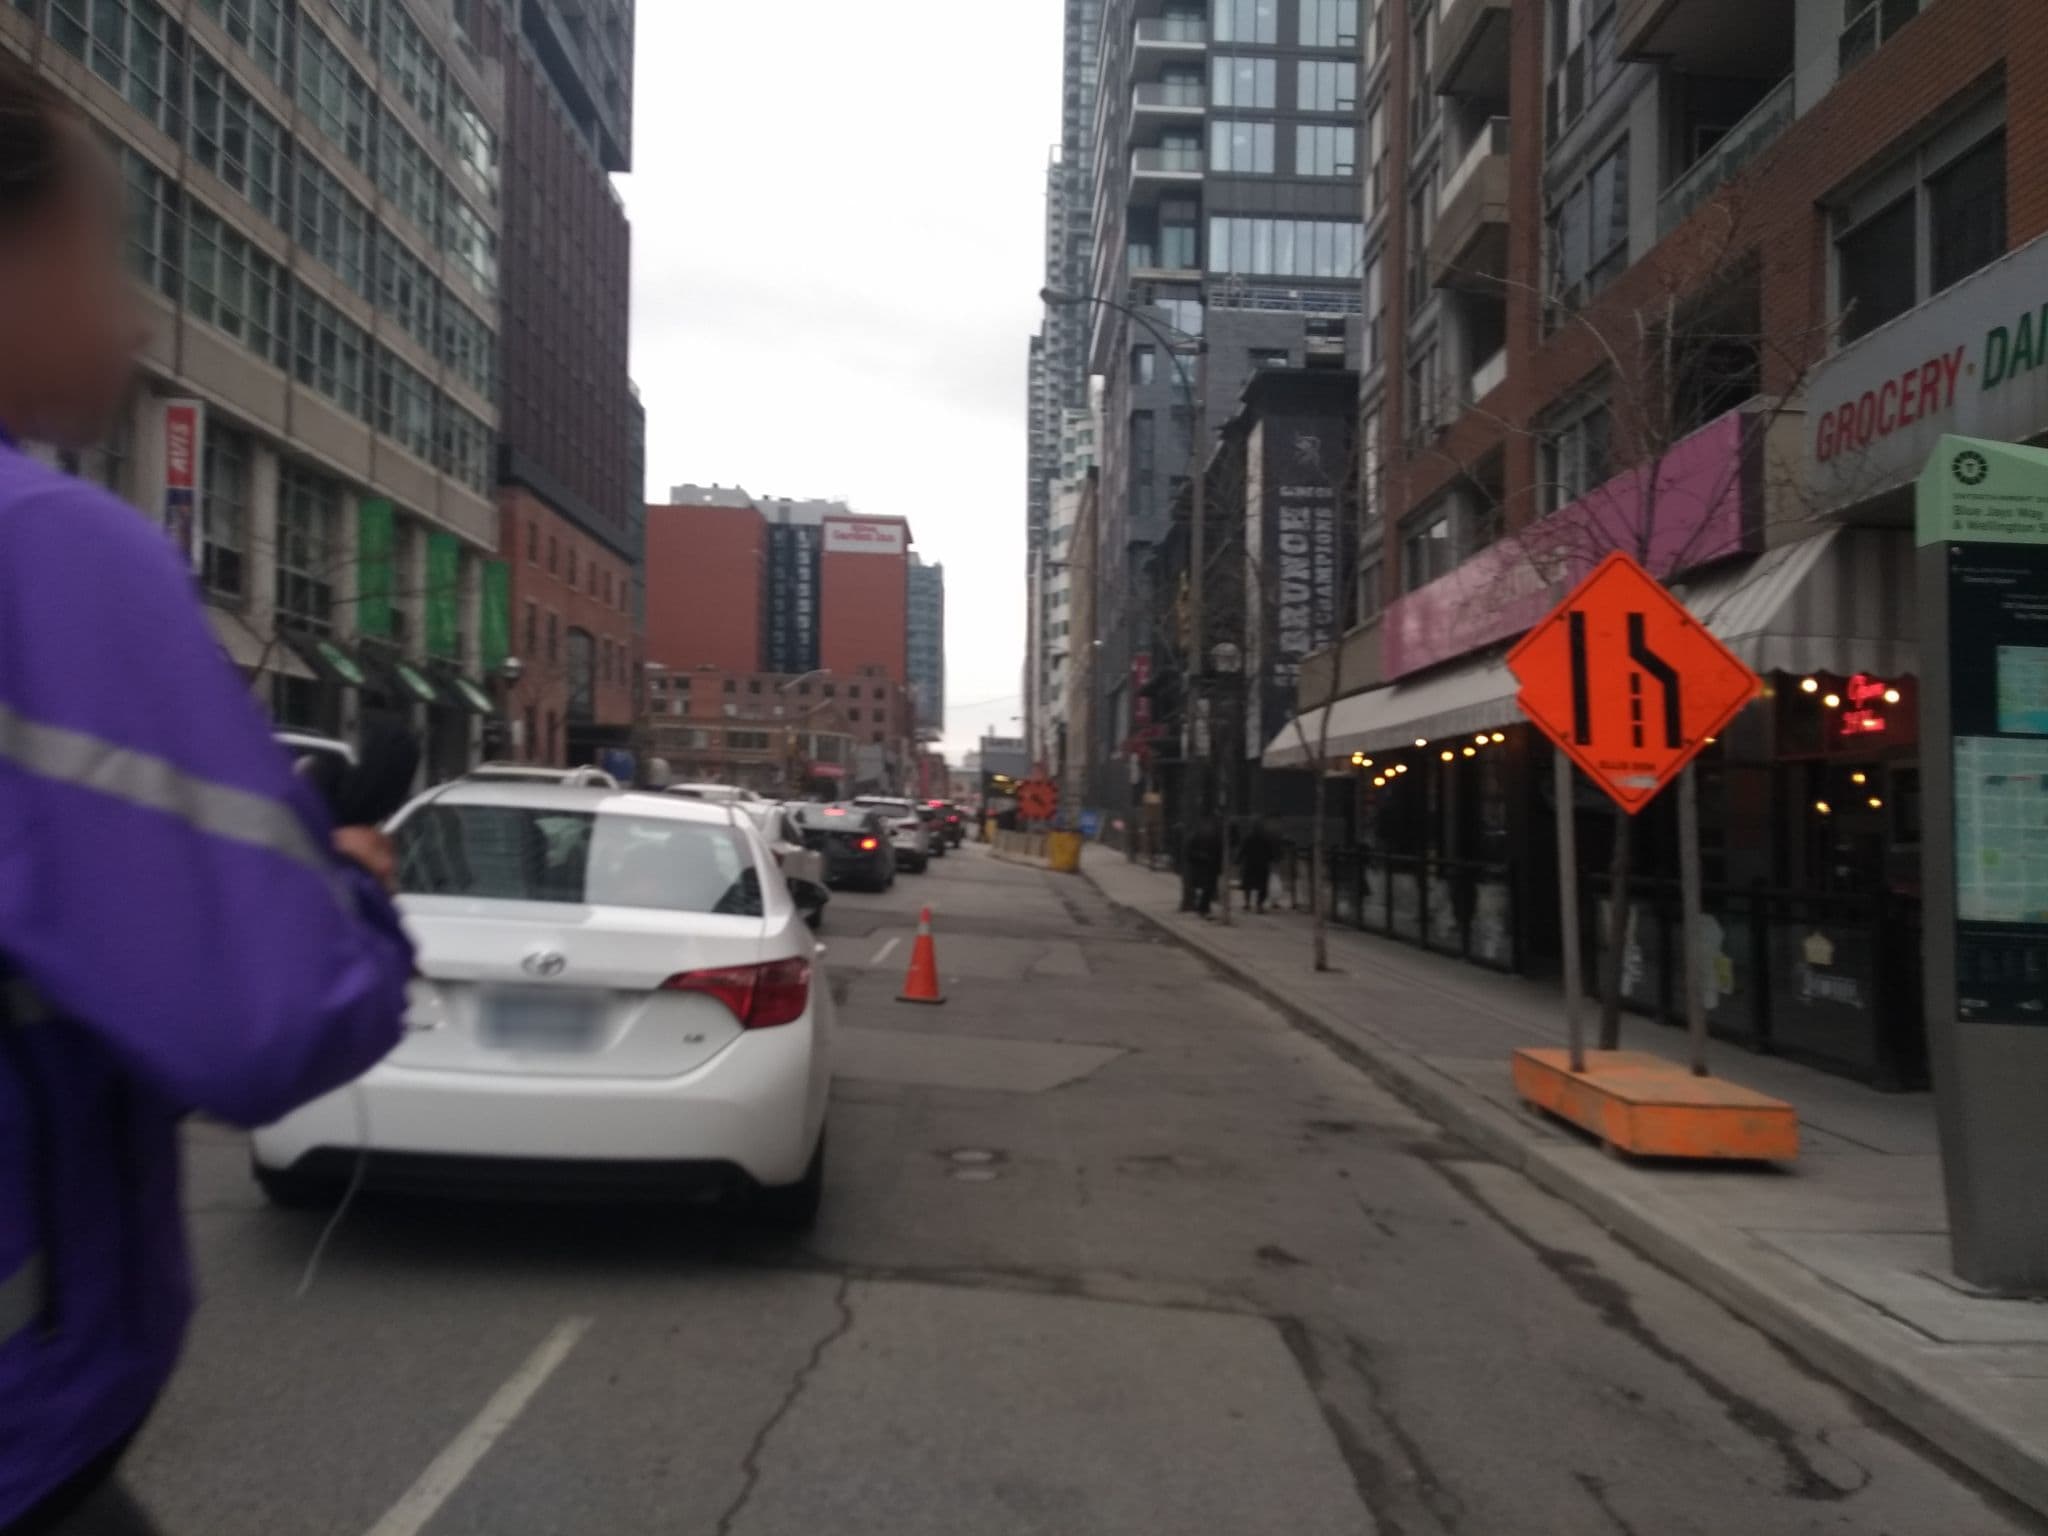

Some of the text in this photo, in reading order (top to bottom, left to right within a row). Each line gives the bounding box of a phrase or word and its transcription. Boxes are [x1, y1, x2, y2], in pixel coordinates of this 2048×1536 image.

[168, 422, 189, 473] AVIS
[1816, 345, 1965, 462] GROCERY
[1280, 506, 1310, 653] BRUNCH
[1314, 507, 1333, 624] CHAMPIONS
